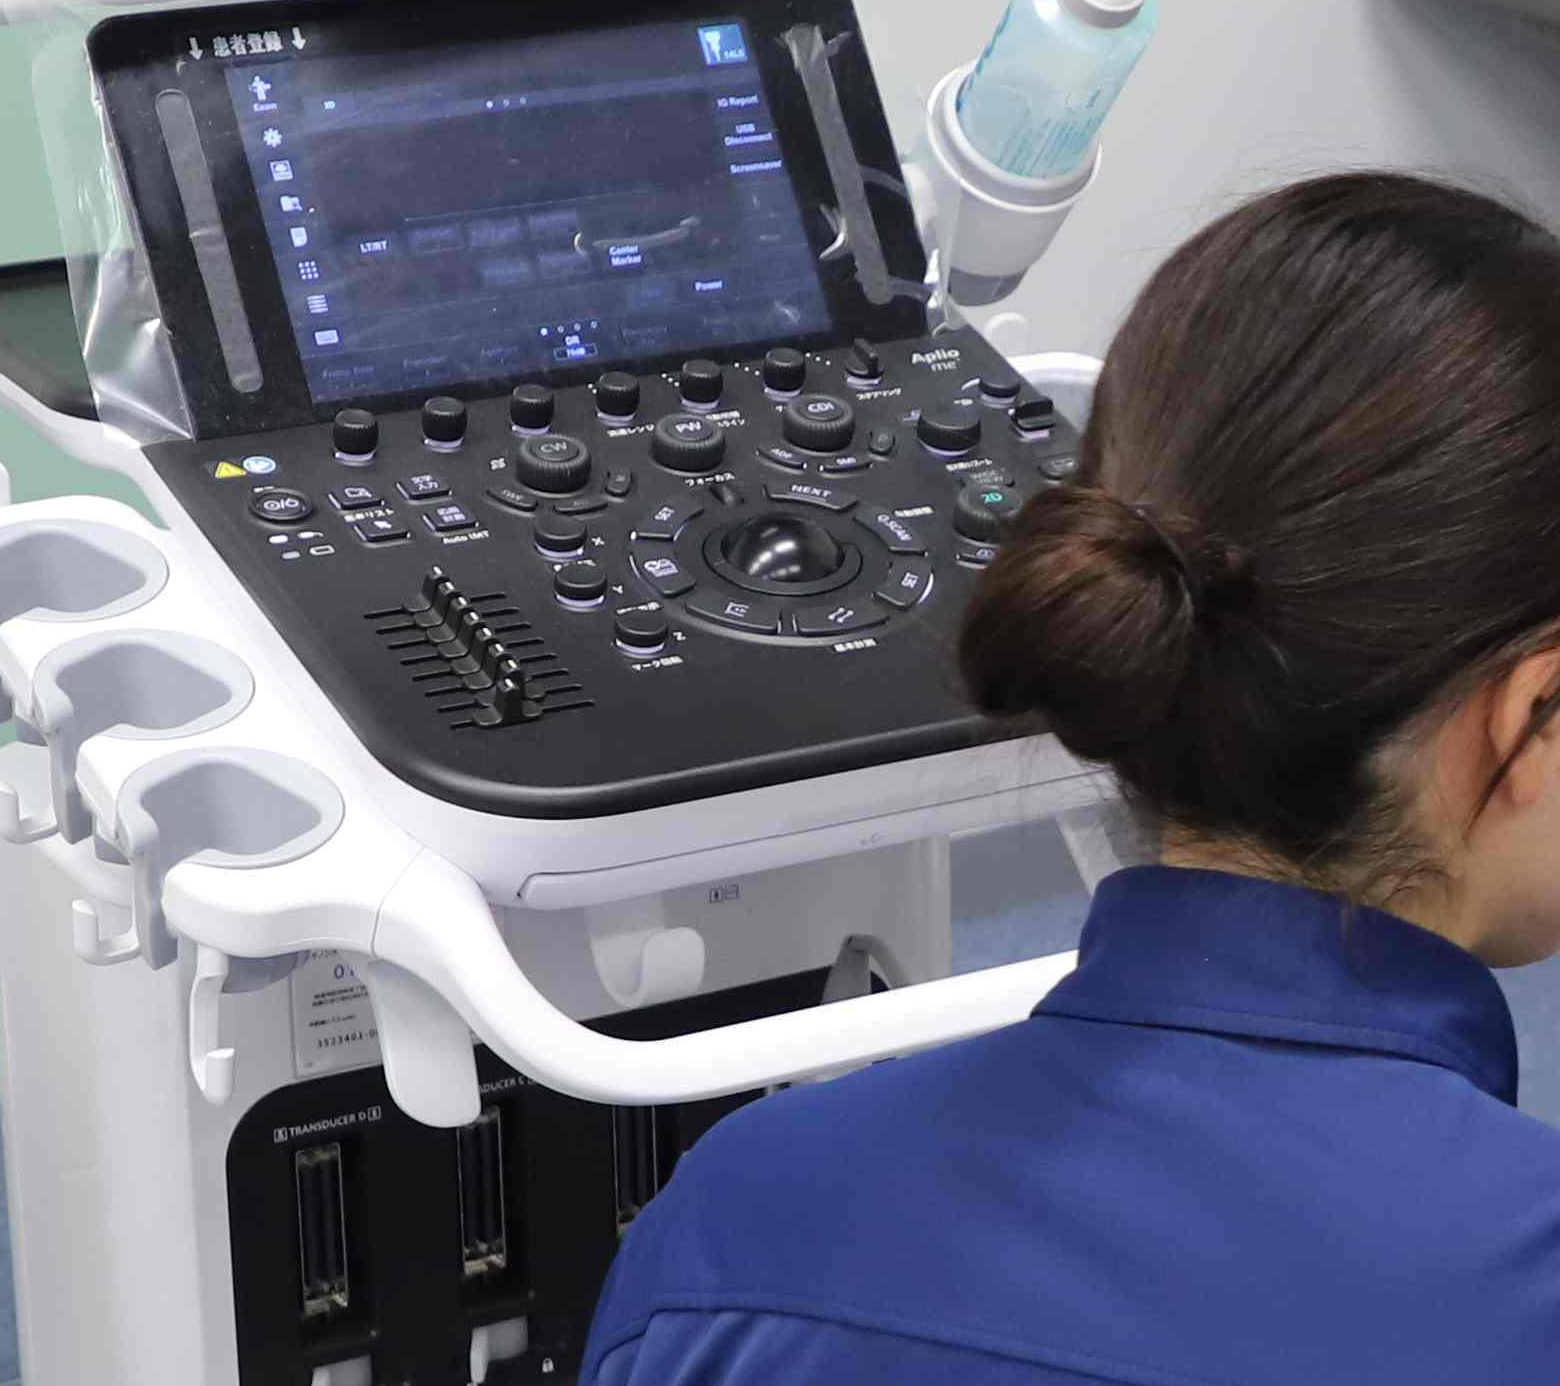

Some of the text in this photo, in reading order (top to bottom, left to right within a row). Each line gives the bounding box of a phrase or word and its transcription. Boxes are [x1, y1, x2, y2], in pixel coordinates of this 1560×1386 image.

[912, 347, 960, 364] Aplio
[931, 359, 957, 372] me
[808, 401, 835, 414] CDI
[675, 420, 701, 433] PW
[540, 441, 568, 454] CW
[791, 483, 832, 498] NEXT
[289, 1111, 367, 1137] TRANSDUCER D
